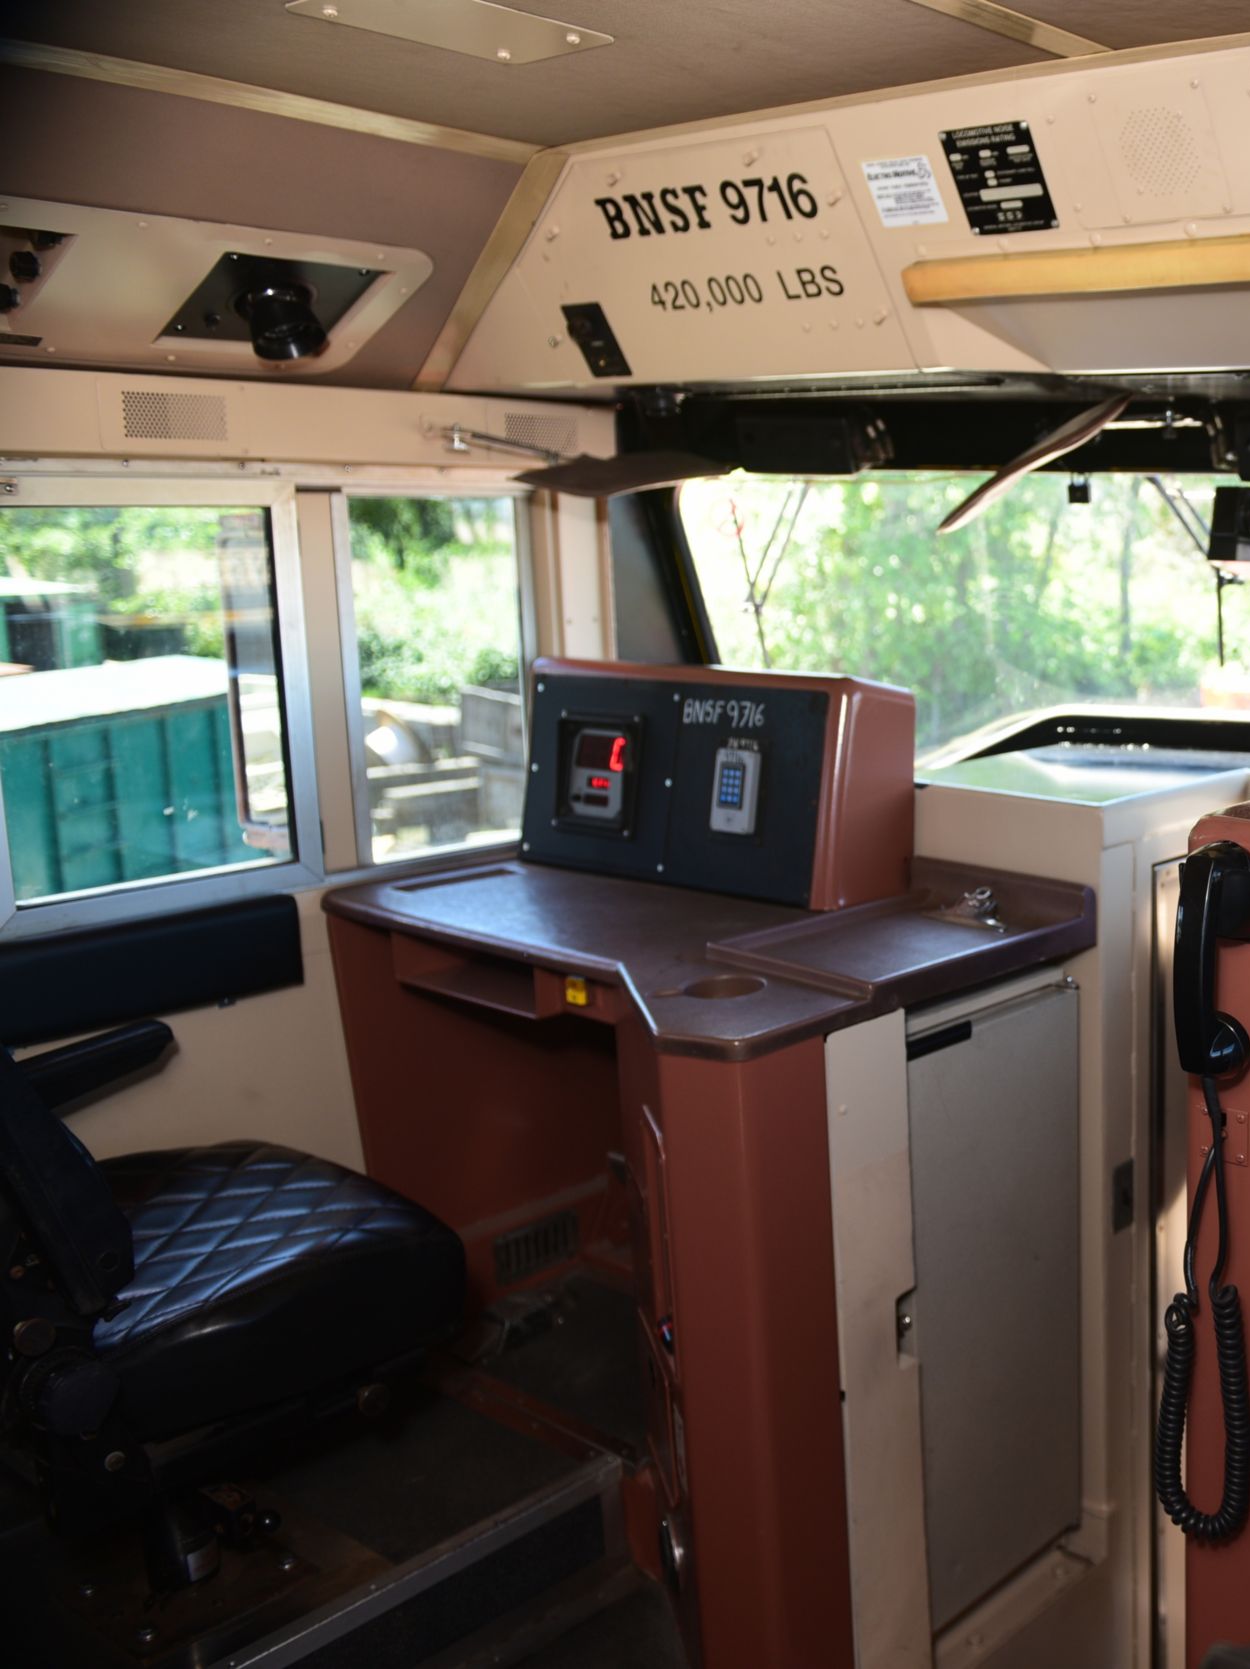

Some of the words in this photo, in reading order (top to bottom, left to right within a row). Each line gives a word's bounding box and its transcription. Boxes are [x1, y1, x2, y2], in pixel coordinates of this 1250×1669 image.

[595, 184, 712, 240] BNSF
[719, 172, 819, 226] 9716
[649, 273, 764, 313] 420,000
[776, 265, 845, 300] LBS
[683, 698, 725, 725] BNSF
[726, 699, 765, 729] 9716
